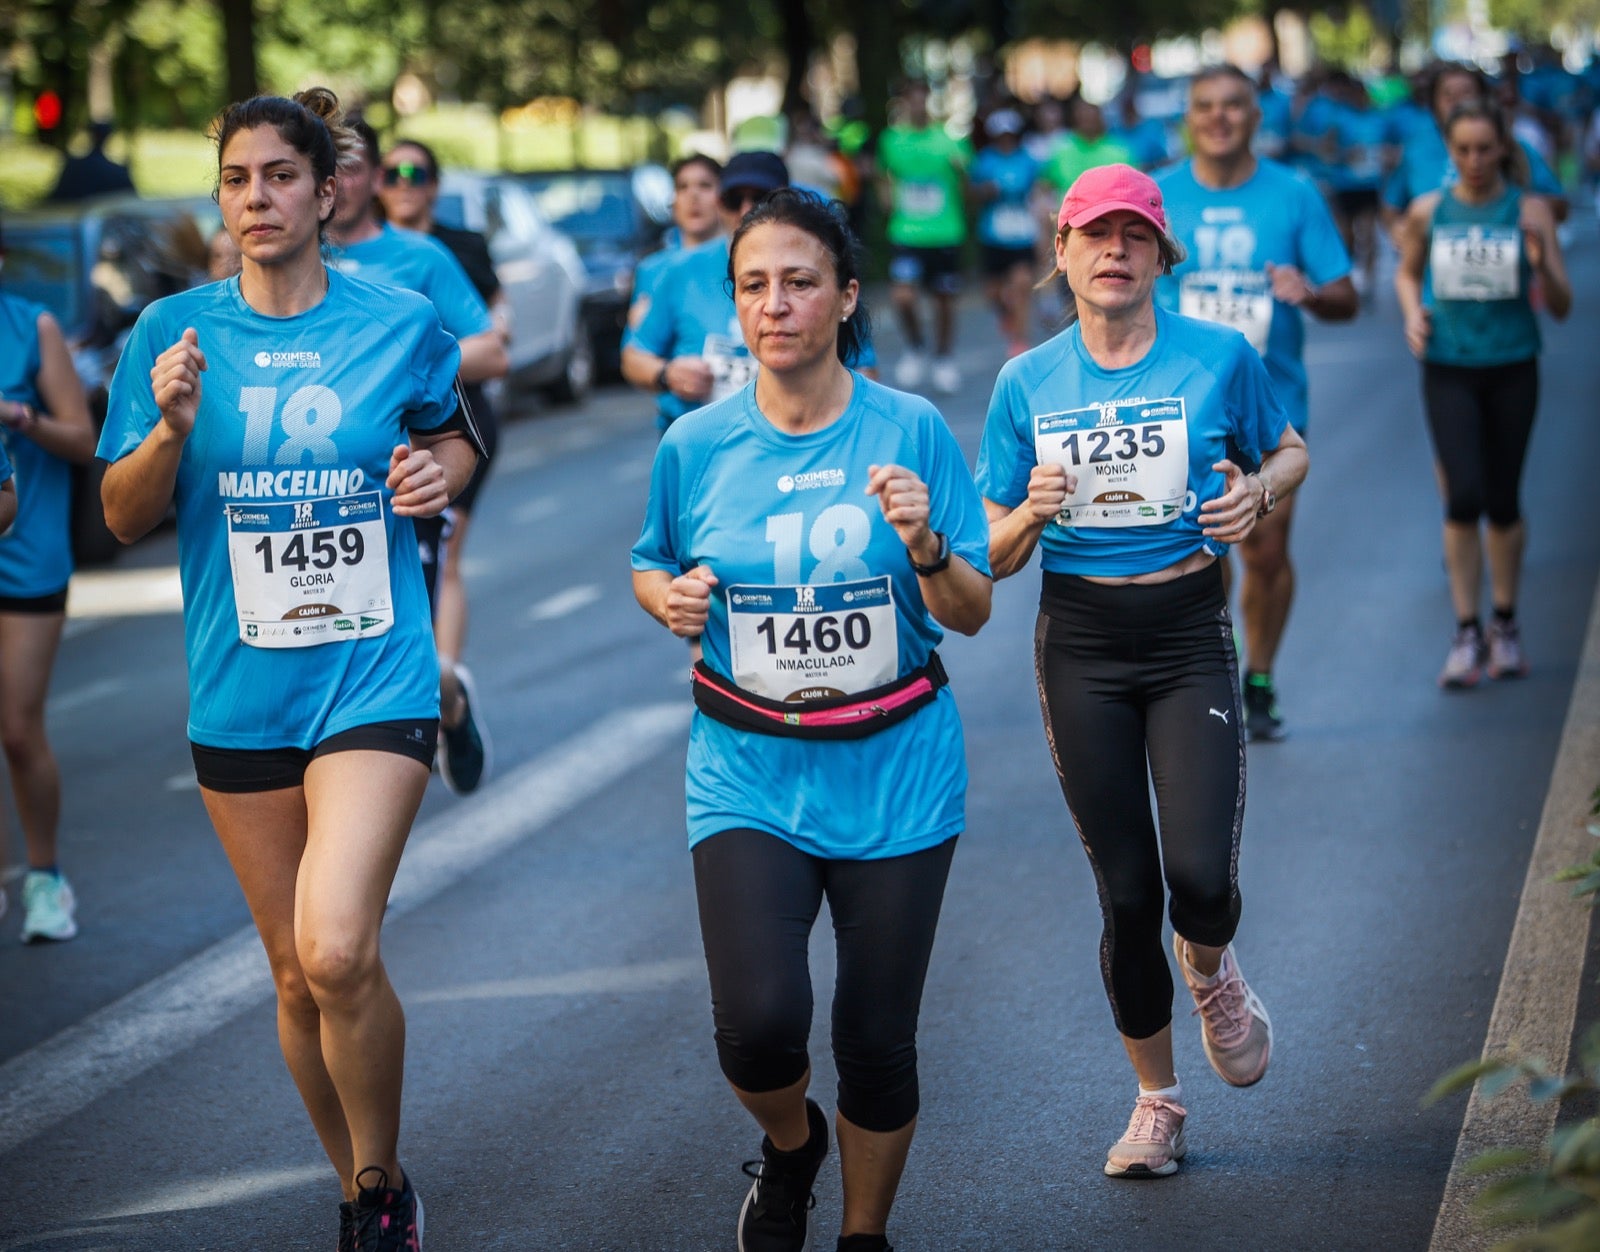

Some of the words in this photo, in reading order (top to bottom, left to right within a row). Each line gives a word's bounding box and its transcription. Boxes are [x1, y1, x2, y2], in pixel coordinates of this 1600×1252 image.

[272, 351, 321, 361] OXIMESA
[1104, 396, 1147, 407] OXIMESA
[238, 384, 343, 467] 18
[1061, 424, 1165, 466] 1235
[794, 468, 844, 483] OXIMESA
[1095, 463, 1137, 476] MÓNICA
[218, 468, 364, 498] MARCELINO
[795, 481, 822, 491] NIPPON
[294, 502, 313, 518] 18
[349, 501, 377, 511] OXIMESA
[255, 527, 365, 574] 1459
[765, 503, 871, 586] 18
[290, 572, 335, 588] GLORIA
[795, 587, 815, 602] 18
[299, 606, 320, 616] CAJÓN
[320, 606, 326, 614] 4
[757, 612, 871, 655] 1460
[776, 655, 855, 671] INMACULADA
[801, 689, 822, 698] CAJÓN
[823, 689, 829, 697] 4
